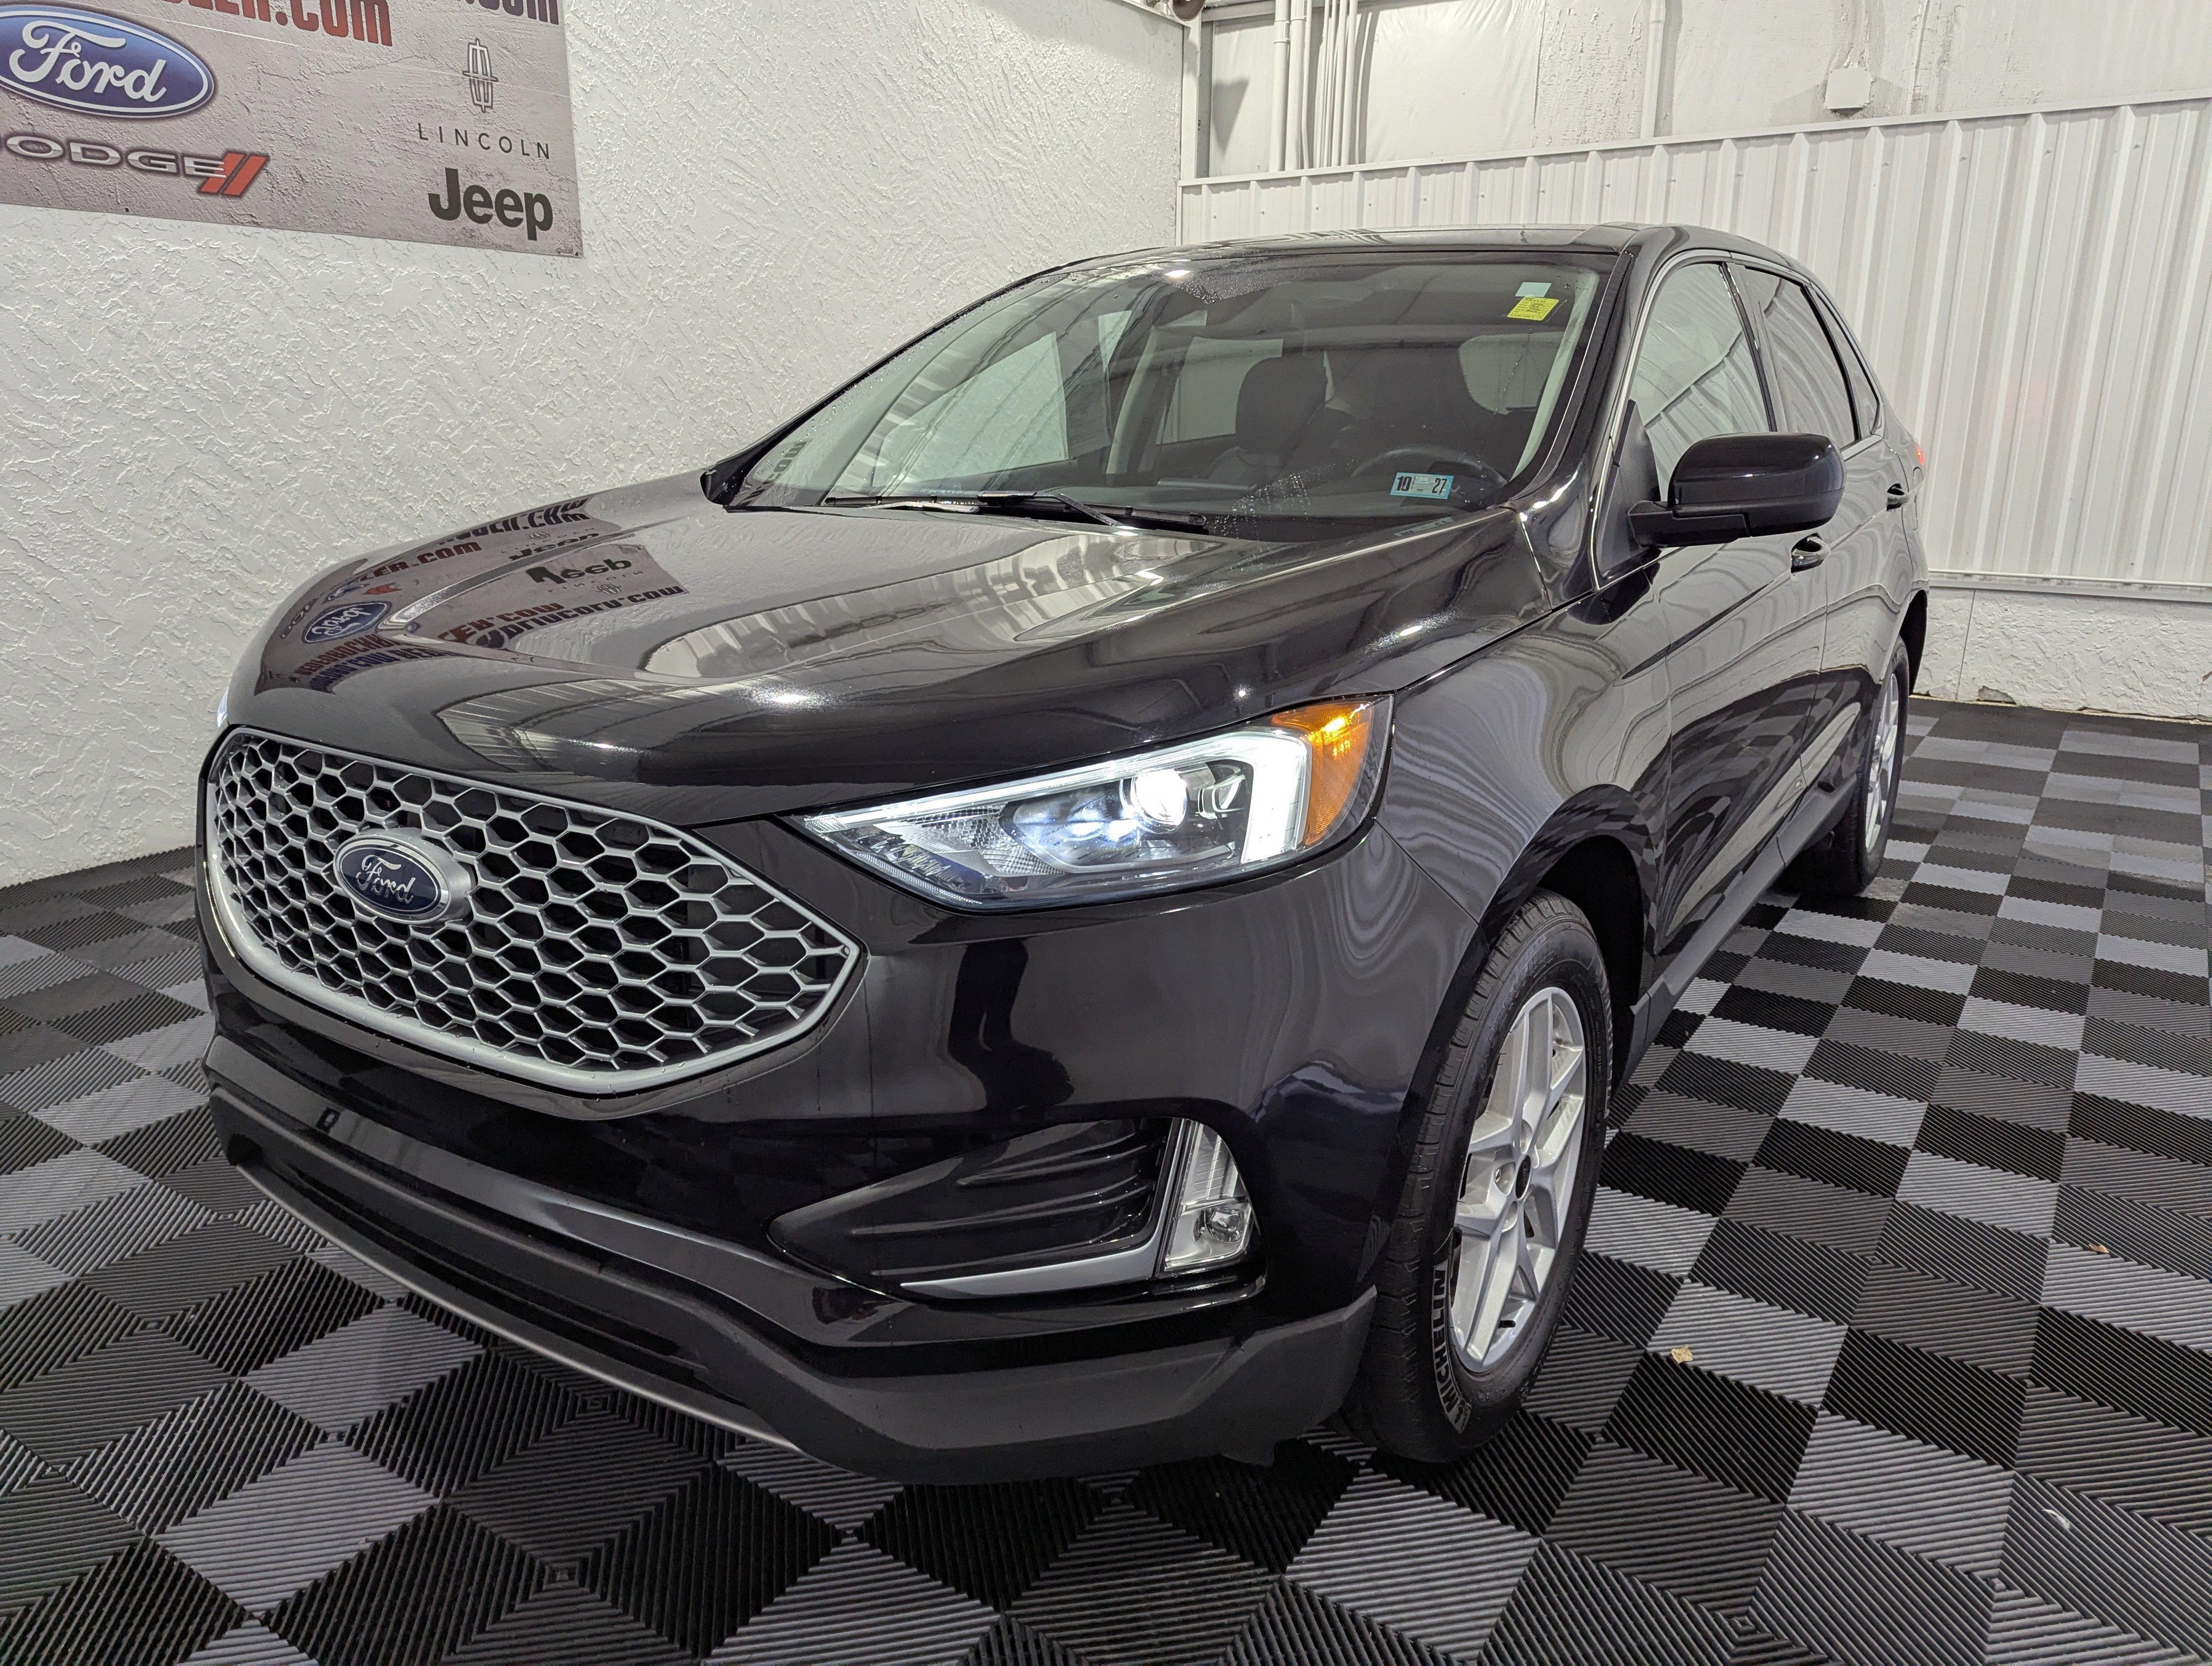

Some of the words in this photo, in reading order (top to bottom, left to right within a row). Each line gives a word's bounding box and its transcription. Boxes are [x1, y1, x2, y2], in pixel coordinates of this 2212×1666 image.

[9, 20, 167, 102] Ford
[6, 136, 227, 178] ODGE
[418, 123, 550, 159] LINCOLN
[428, 167, 553, 241] Jeep
[1397, 476, 1412, 491] 10
[1431, 477, 1448, 495] 27
[355, 854, 416, 905] Ford
[1432, 1268, 1459, 1414] MICHELIN
